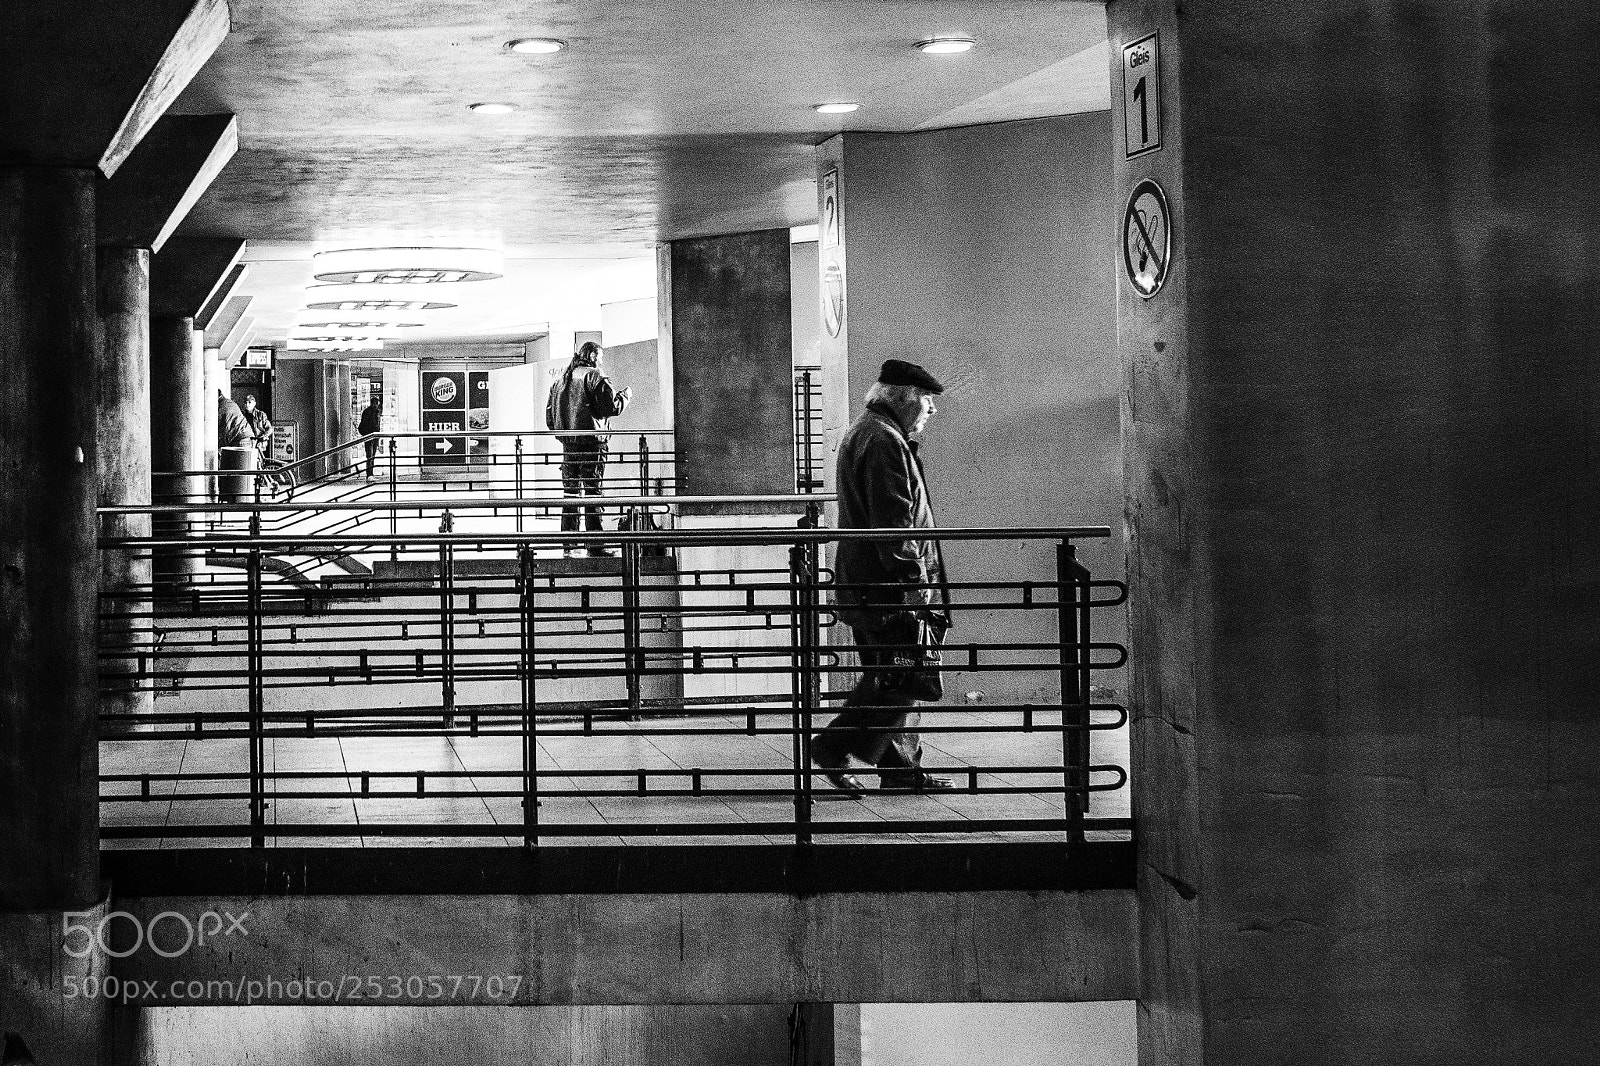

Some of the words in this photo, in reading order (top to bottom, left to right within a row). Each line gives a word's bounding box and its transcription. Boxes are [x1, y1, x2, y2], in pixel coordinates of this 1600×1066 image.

[1130, 50, 1150, 69] Gleis
[1134, 77, 1148, 144] 1
[435, 386, 454, 399] KING
[428, 422, 460, 431] HIER
